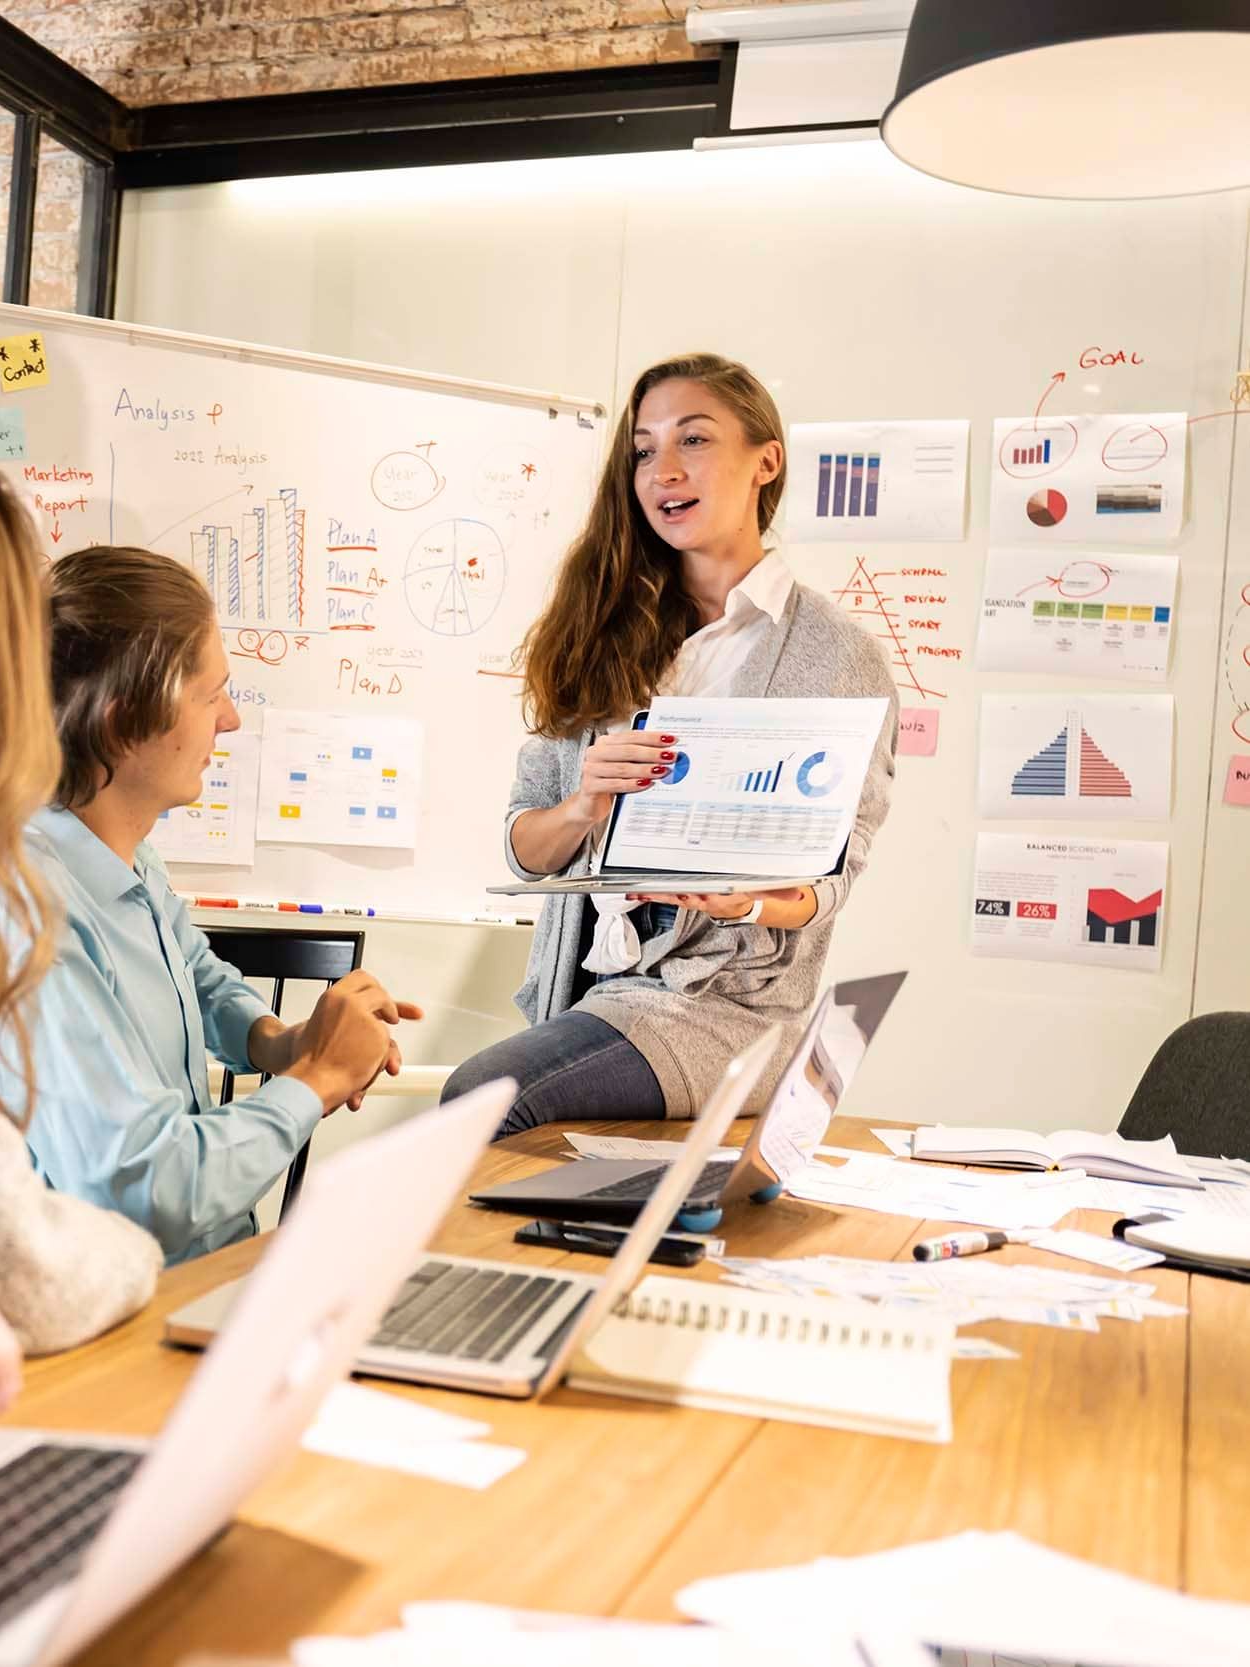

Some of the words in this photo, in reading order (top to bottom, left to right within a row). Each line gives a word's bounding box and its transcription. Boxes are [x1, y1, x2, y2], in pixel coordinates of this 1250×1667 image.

[3, 358, 46, 382] Contact
[1079, 346, 1145, 369] GOAL
[114, 387, 197, 431] Analysis
[213, 445, 269, 475] Analysis
[23, 464, 95, 485] Marketing
[35, 494, 89, 517] Report
[327, 518, 361, 545] Plan
[365, 528, 377, 544] A
[327, 560, 359, 585] Plan
[327, 597, 356, 625] Plan
[361, 602, 374, 623] C
[336, 657, 382, 695] Plan
[387, 673, 403, 695] D
[229, 677, 267, 709] lysis
[1026, 842, 1068, 853] BALANCED
[977, 901, 1005, 915] 74%
[1023, 904, 1051, 918] 26%
